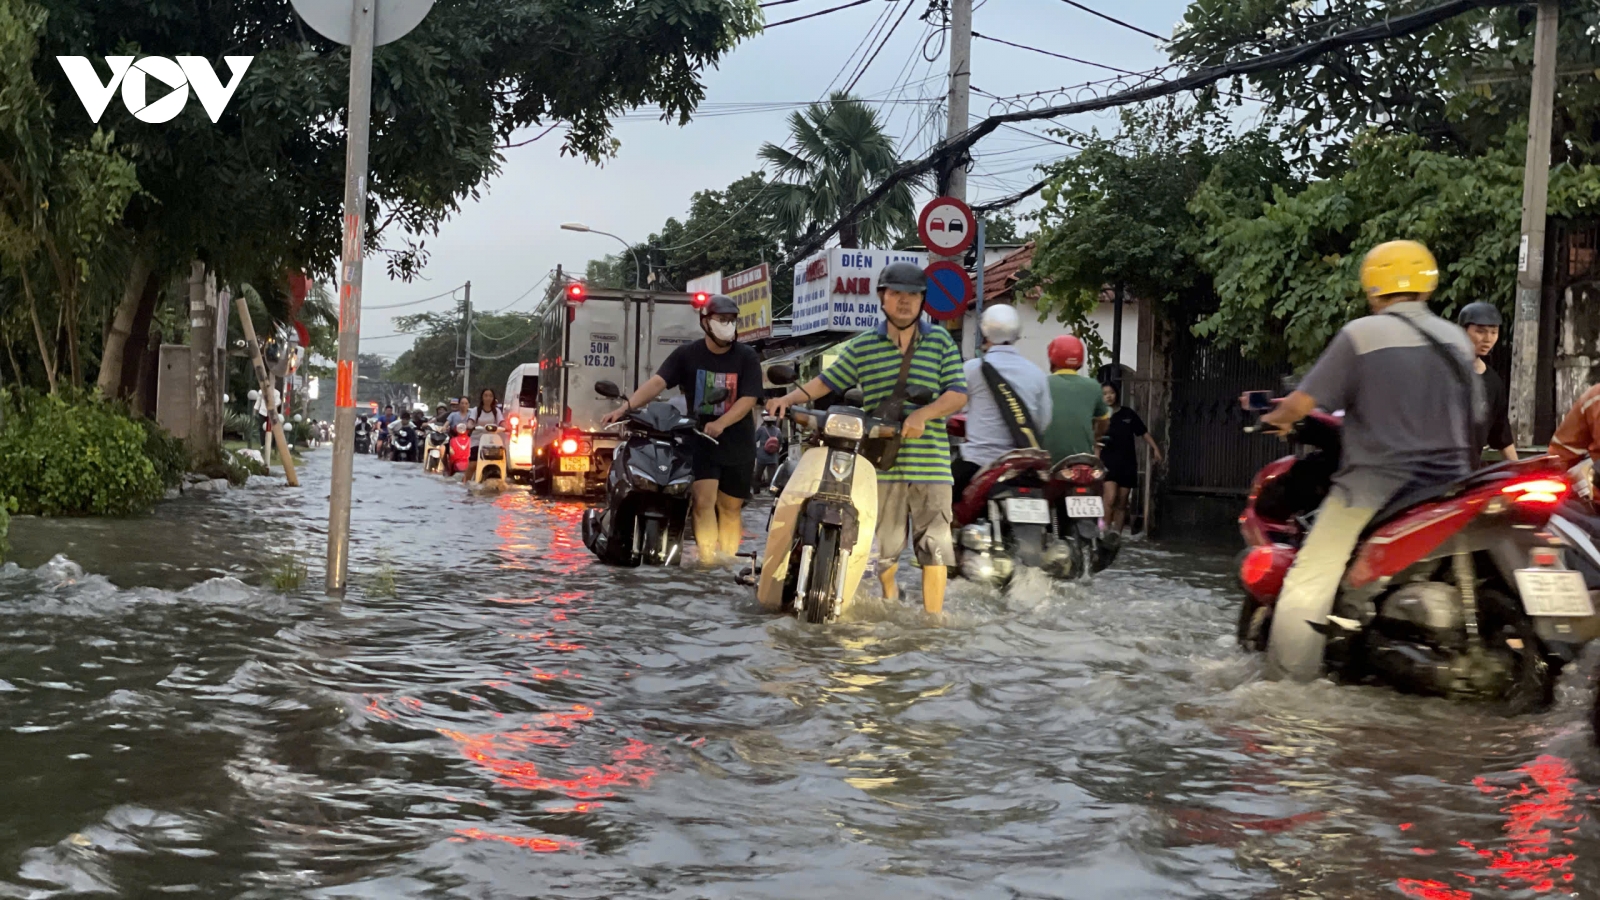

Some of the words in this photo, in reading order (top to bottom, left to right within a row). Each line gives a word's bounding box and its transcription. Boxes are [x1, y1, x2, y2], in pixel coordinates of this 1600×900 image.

[842, 252, 872, 270] ĐIỆN
[833, 276, 870, 295] ANH
[834, 302, 854, 313] MUA
[858, 301, 878, 314] BÁN
[855, 314, 879, 327] CHỮA
[591, 341, 609, 353] 50H
[584, 355, 616, 367] 126.20
